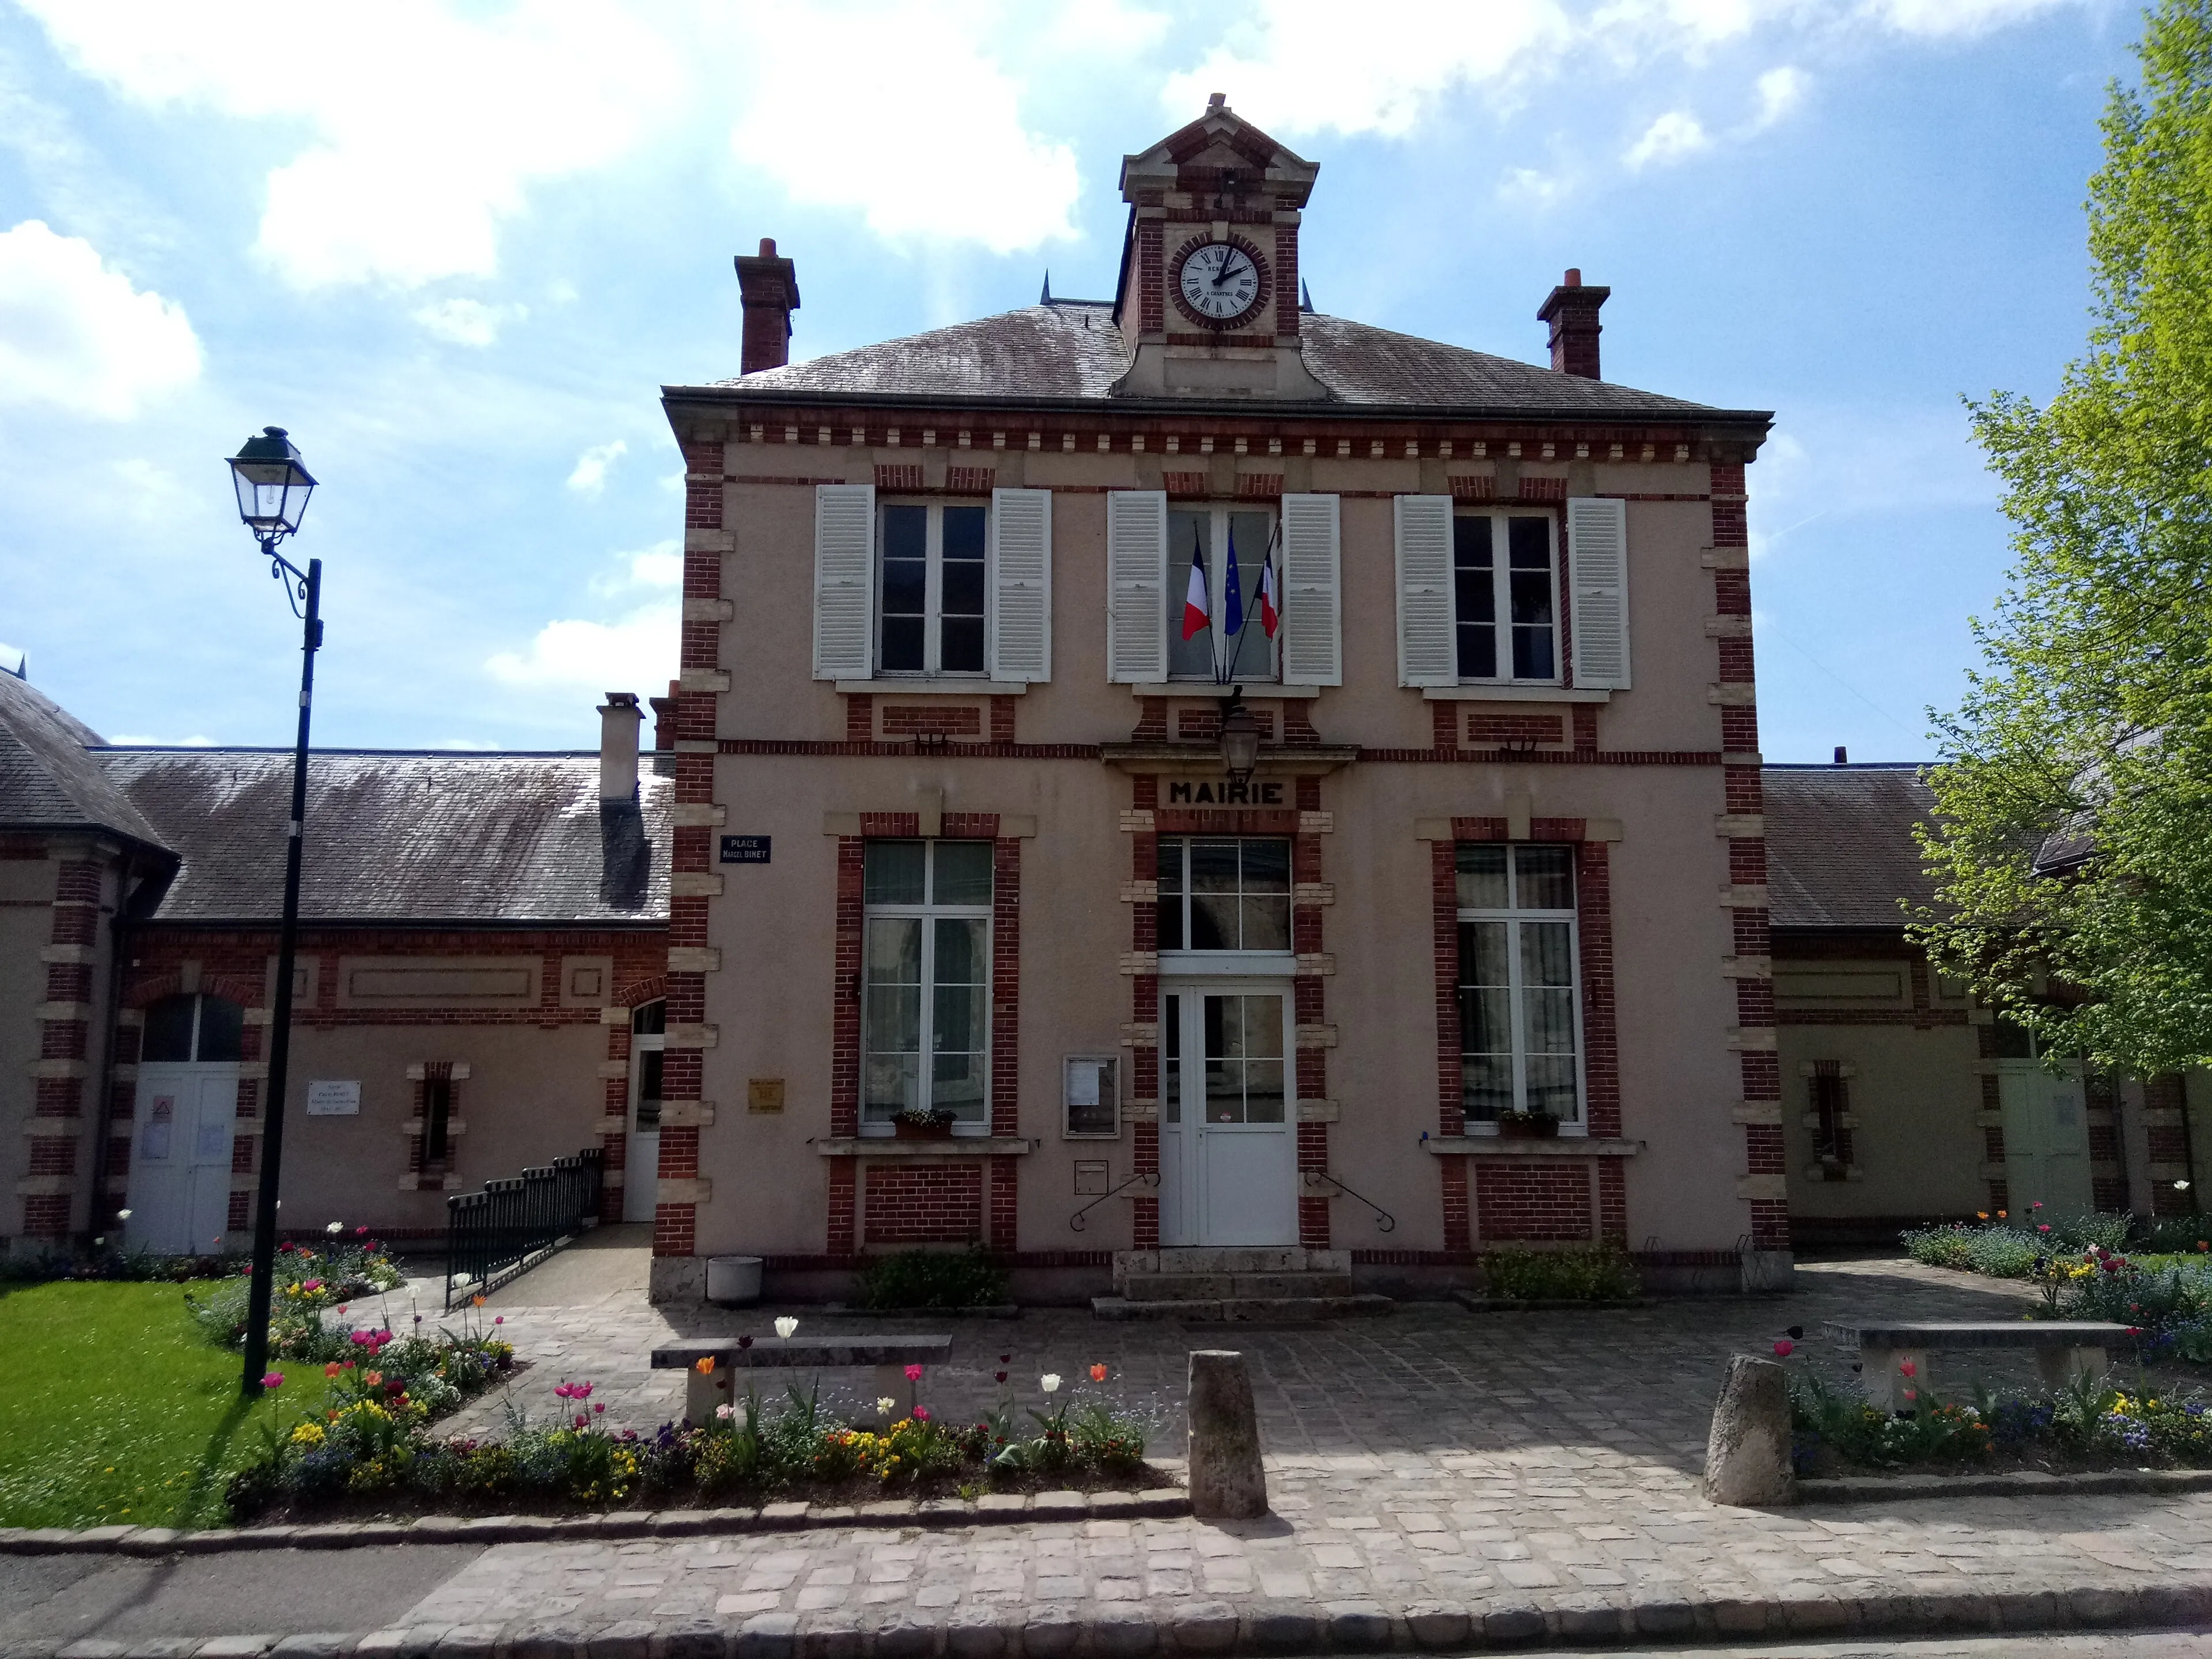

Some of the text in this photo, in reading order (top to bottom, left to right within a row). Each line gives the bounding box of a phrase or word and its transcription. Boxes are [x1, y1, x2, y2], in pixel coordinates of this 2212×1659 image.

[1170, 782, 1283, 804] MAIRIE
[731, 839, 758, 847] PLACE
[723, 850, 743, 858] MARCEL
